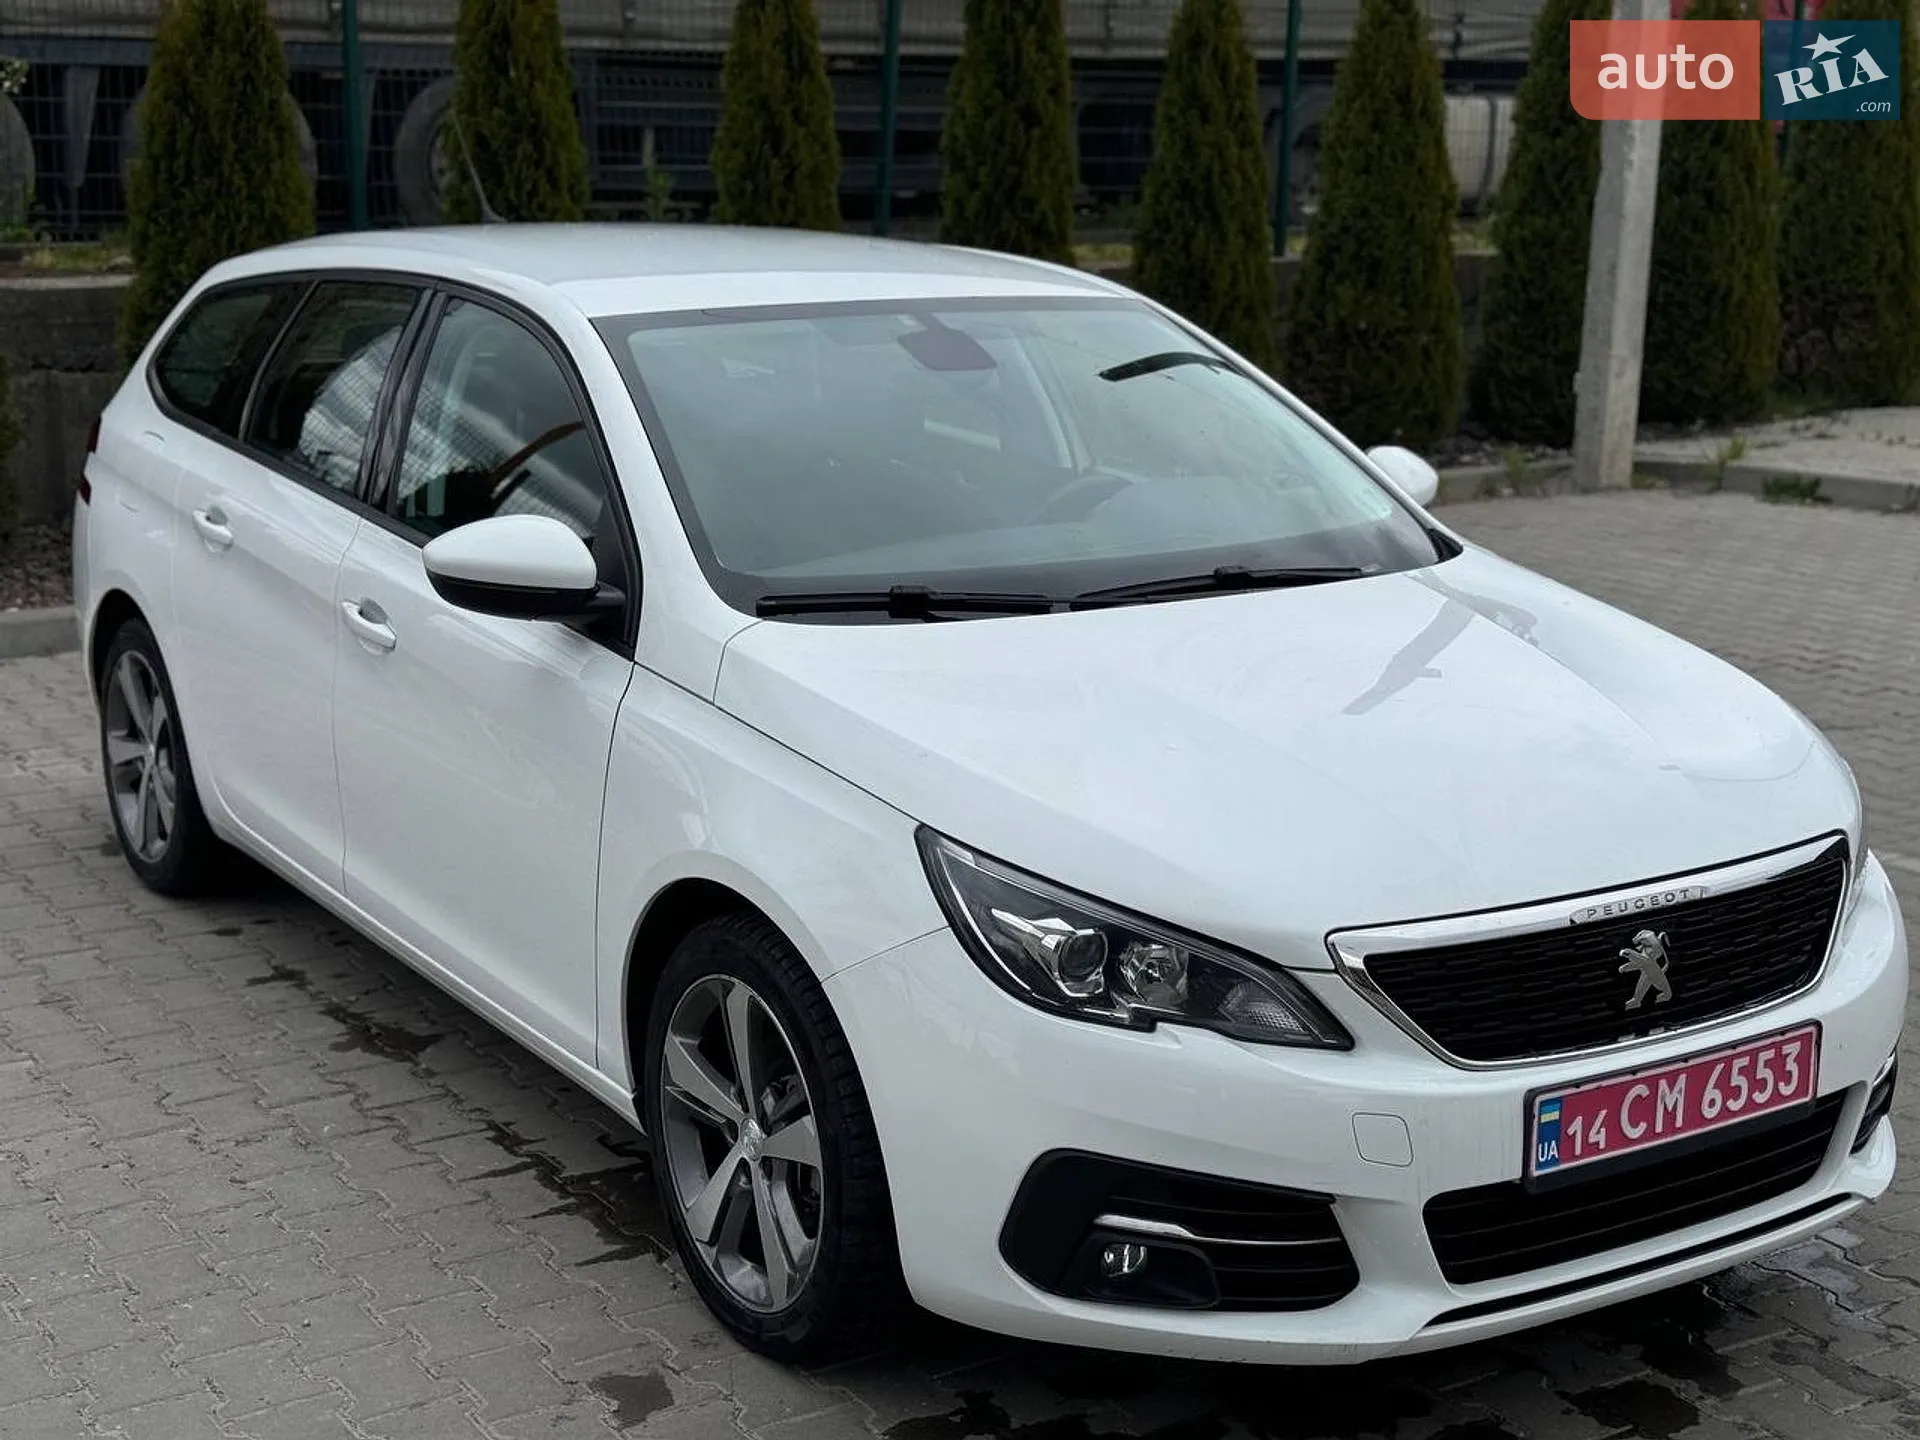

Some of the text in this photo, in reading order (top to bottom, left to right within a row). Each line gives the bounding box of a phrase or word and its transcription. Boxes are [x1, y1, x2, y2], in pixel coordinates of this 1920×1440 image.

[1587, 889, 1689, 919] PEUGEOT
[1566, 1041, 1801, 1156] 14 CM 6553
[1537, 1141, 1559, 1163] UA
